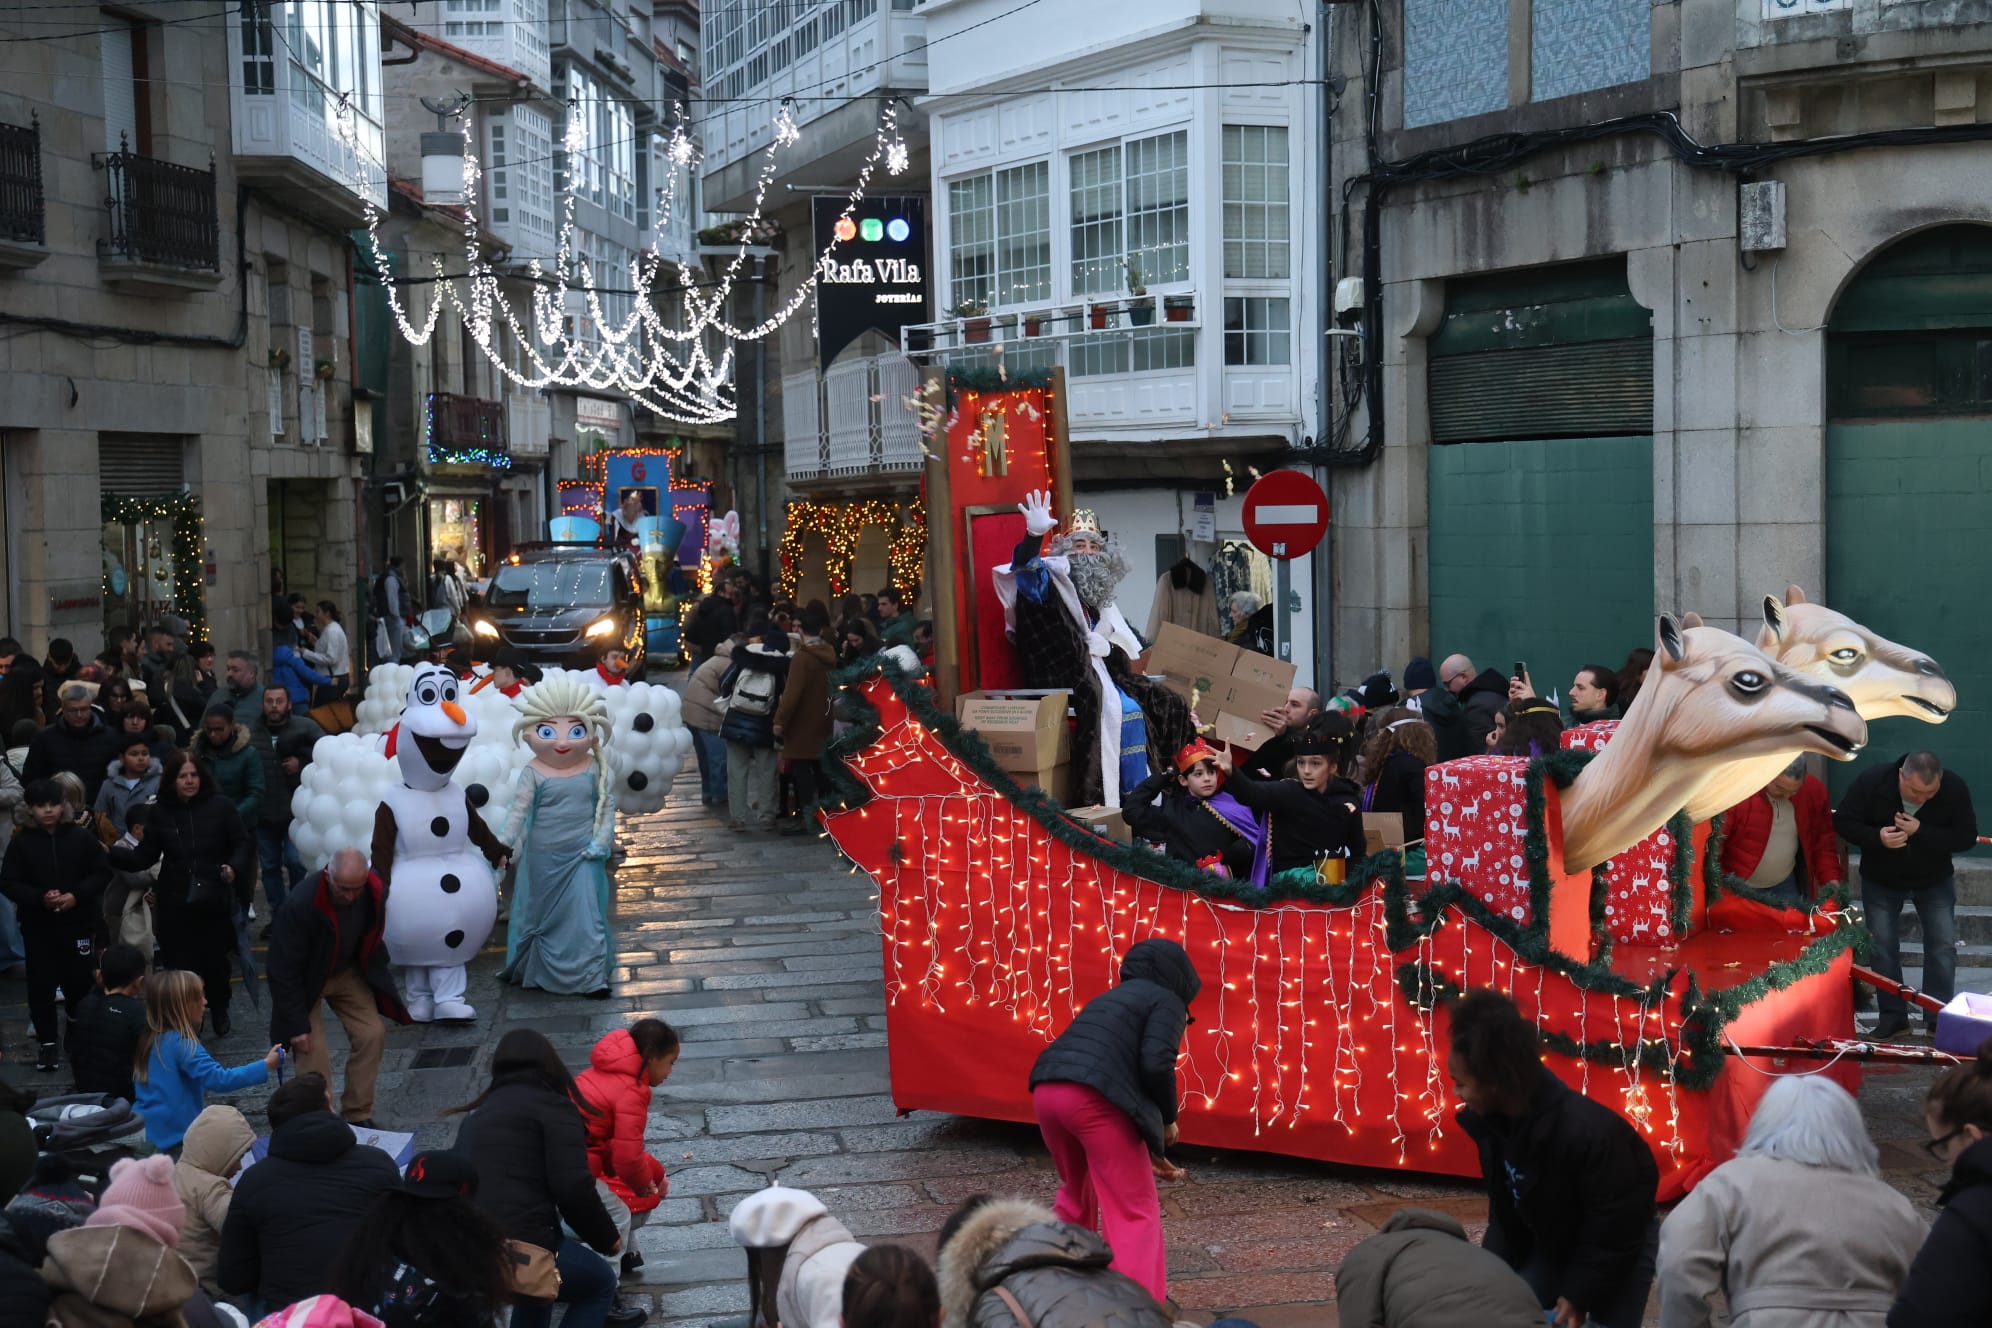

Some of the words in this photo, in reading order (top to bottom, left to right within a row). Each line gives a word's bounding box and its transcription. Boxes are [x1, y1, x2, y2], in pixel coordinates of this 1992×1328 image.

[822, 258, 875, 284] Rafa
[875, 258, 921, 283] Vila
[982, 412, 1008, 477] M
[631, 461, 646, 481] G
